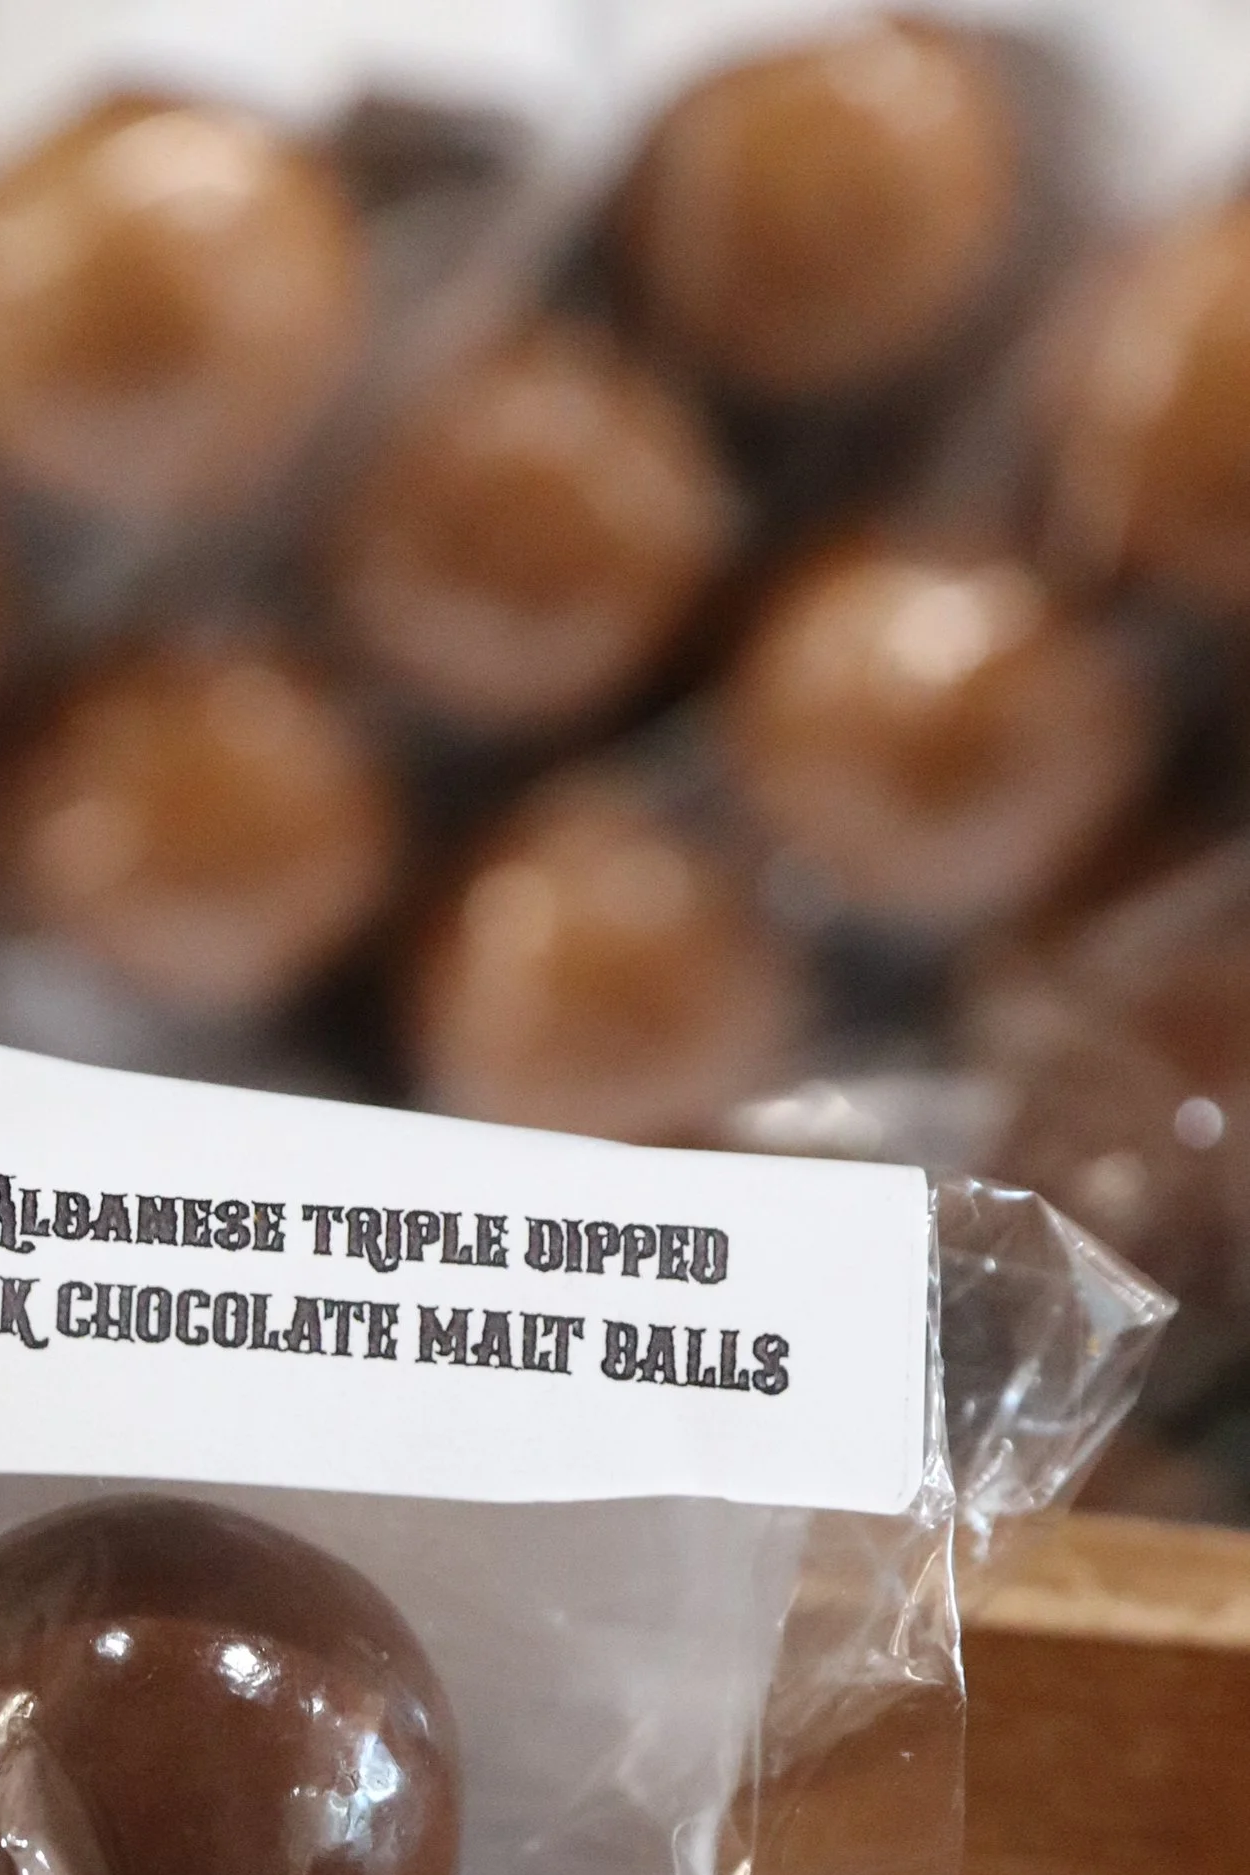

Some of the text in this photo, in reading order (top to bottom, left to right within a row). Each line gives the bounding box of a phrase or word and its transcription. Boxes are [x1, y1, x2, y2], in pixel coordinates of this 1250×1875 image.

[301, 1204, 509, 1274] TRIPLE
[524, 1216, 729, 1285] DIPPED
[56, 1280, 400, 1361] CHOCOLATE
[414, 1304, 585, 1376] MALT
[600, 1319, 790, 1396] BALLS
